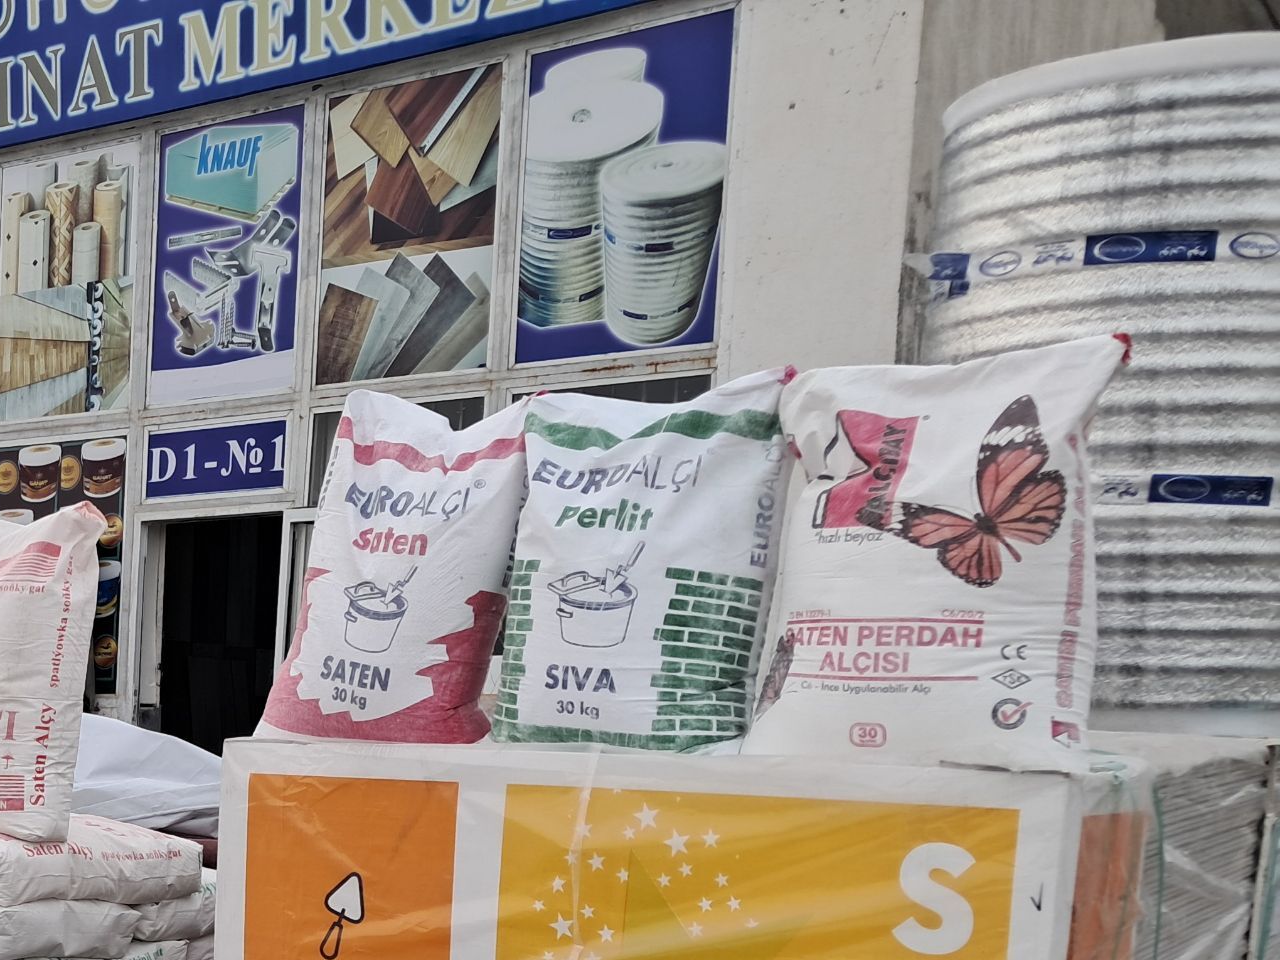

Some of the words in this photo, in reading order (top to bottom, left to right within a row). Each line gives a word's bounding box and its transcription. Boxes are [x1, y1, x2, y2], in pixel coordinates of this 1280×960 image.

[197, 133, 263, 177] KNAUF
[344, 481, 471, 521] EUROALÇI
[856, 625, 984, 648] PERDAH
[320, 654, 391, 692] SATEN
[545, 663, 617, 695] SIVA
[819, 651, 911, 675] ALÇISI
[332, 686, 349, 702] 30
[350, 692, 368, 710] kg
[556, 700, 575, 715] 30
[579, 700, 600, 720] kg
[34, 702, 56, 750] Alçy
[857, 726, 878, 739] 30
[29, 753, 49, 808] Saten
[890, 841, 977, 956] S
